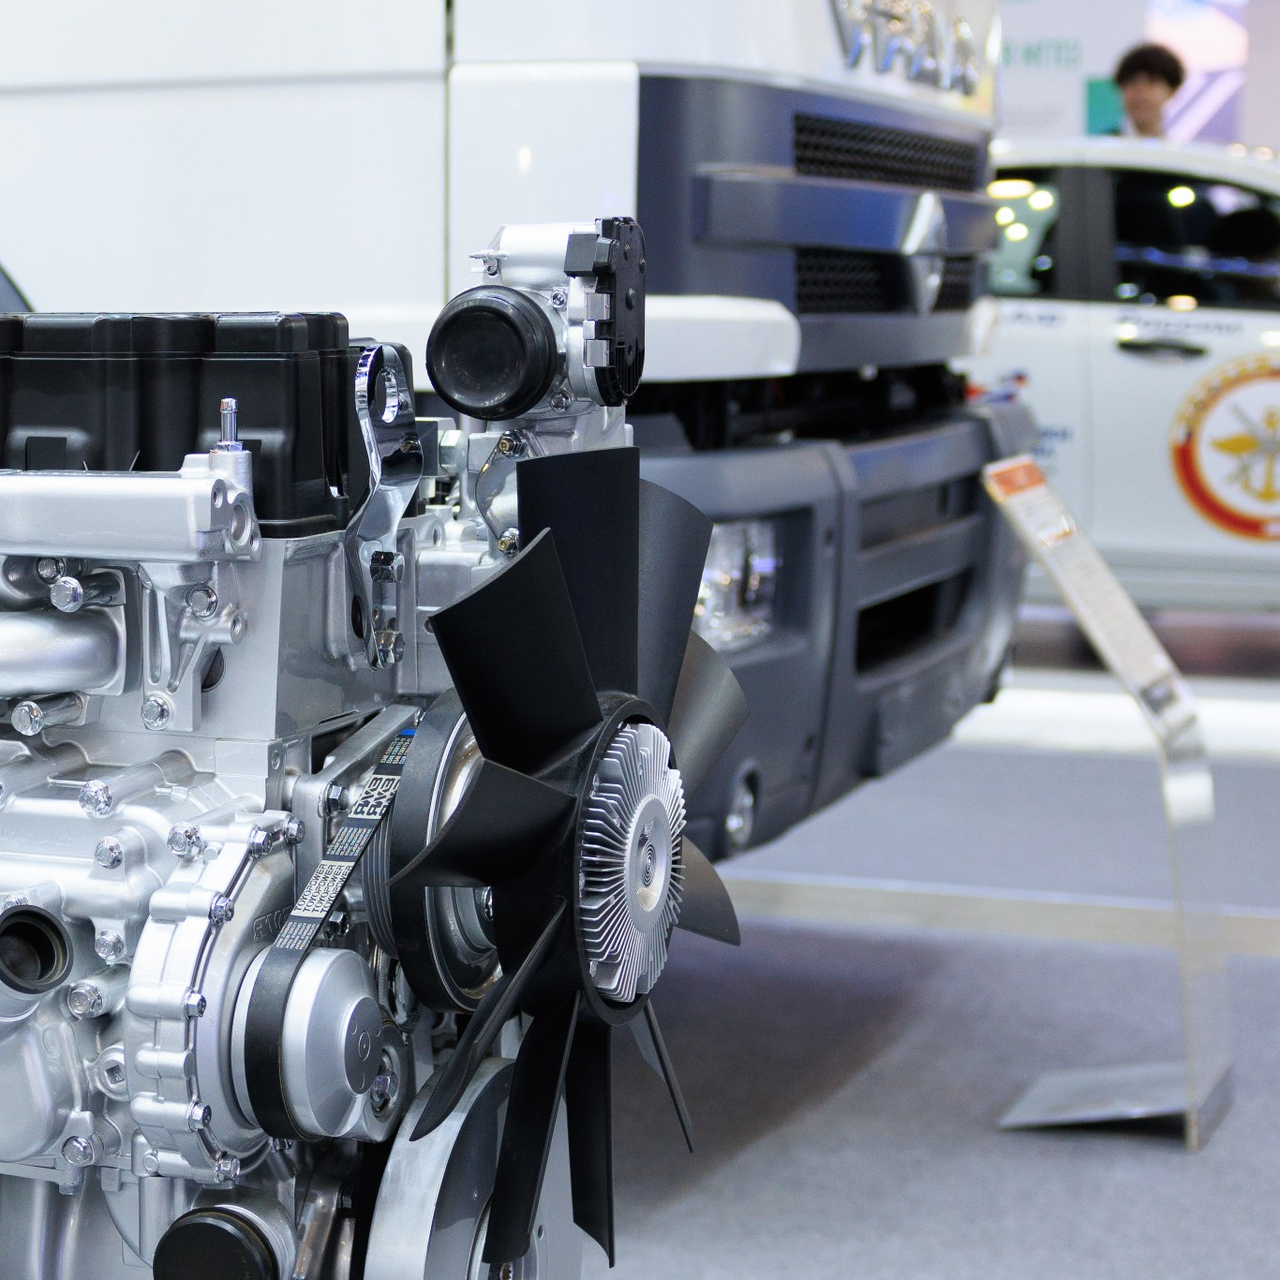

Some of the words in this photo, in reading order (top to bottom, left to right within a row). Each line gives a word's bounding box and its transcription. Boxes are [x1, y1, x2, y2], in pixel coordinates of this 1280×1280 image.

[293, 864, 327, 911] TOYOPOWER
[303, 864, 336, 912] TOYOPOWER
[311, 865, 344, 913] TOYOPOWER
[320, 866, 353, 913] TOYOPOWER
